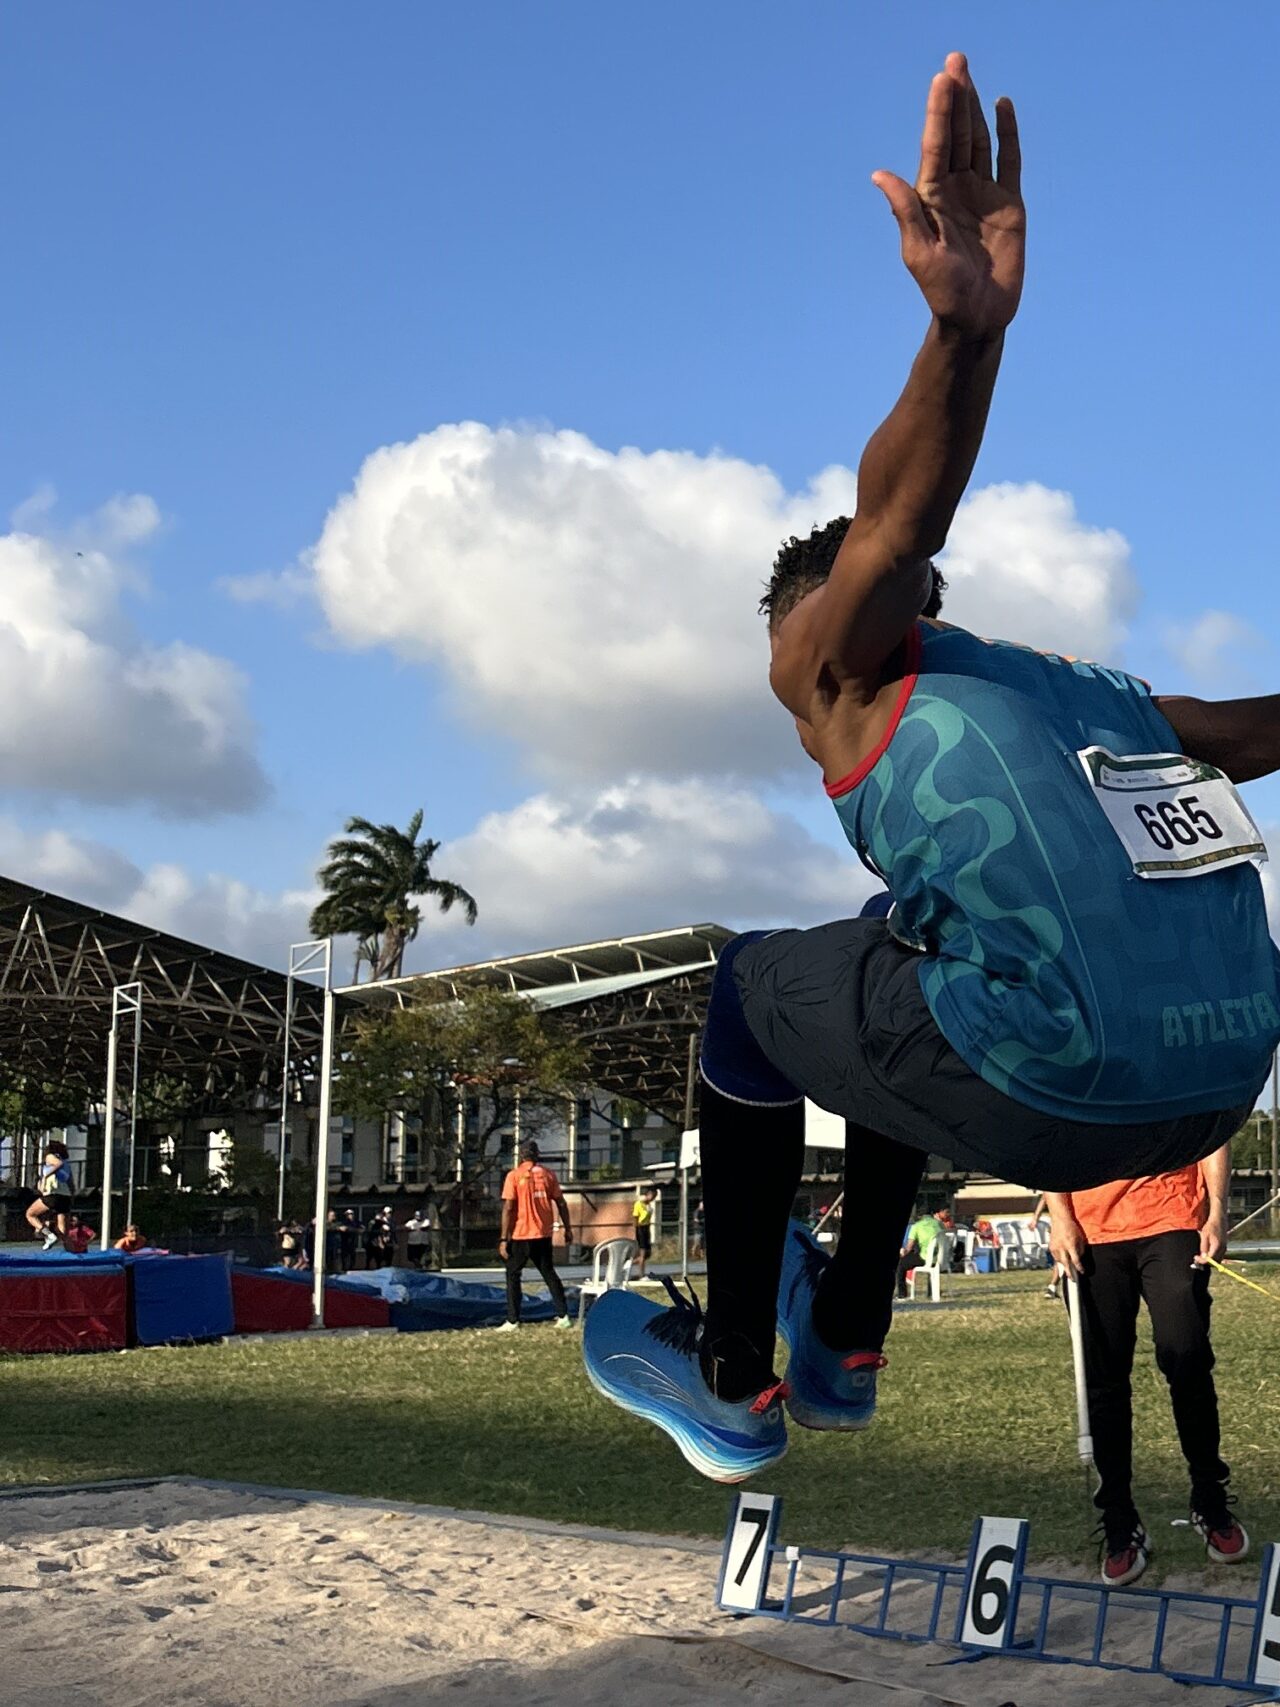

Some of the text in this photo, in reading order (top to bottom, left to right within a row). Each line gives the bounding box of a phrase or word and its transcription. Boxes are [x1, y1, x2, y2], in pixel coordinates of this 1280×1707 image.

[1134, 796, 1223, 850] 665
[1162, 991, 1280, 1047] ATLETA
[734, 1507, 770, 1587] 7
[971, 1545, 1017, 1635] 6
